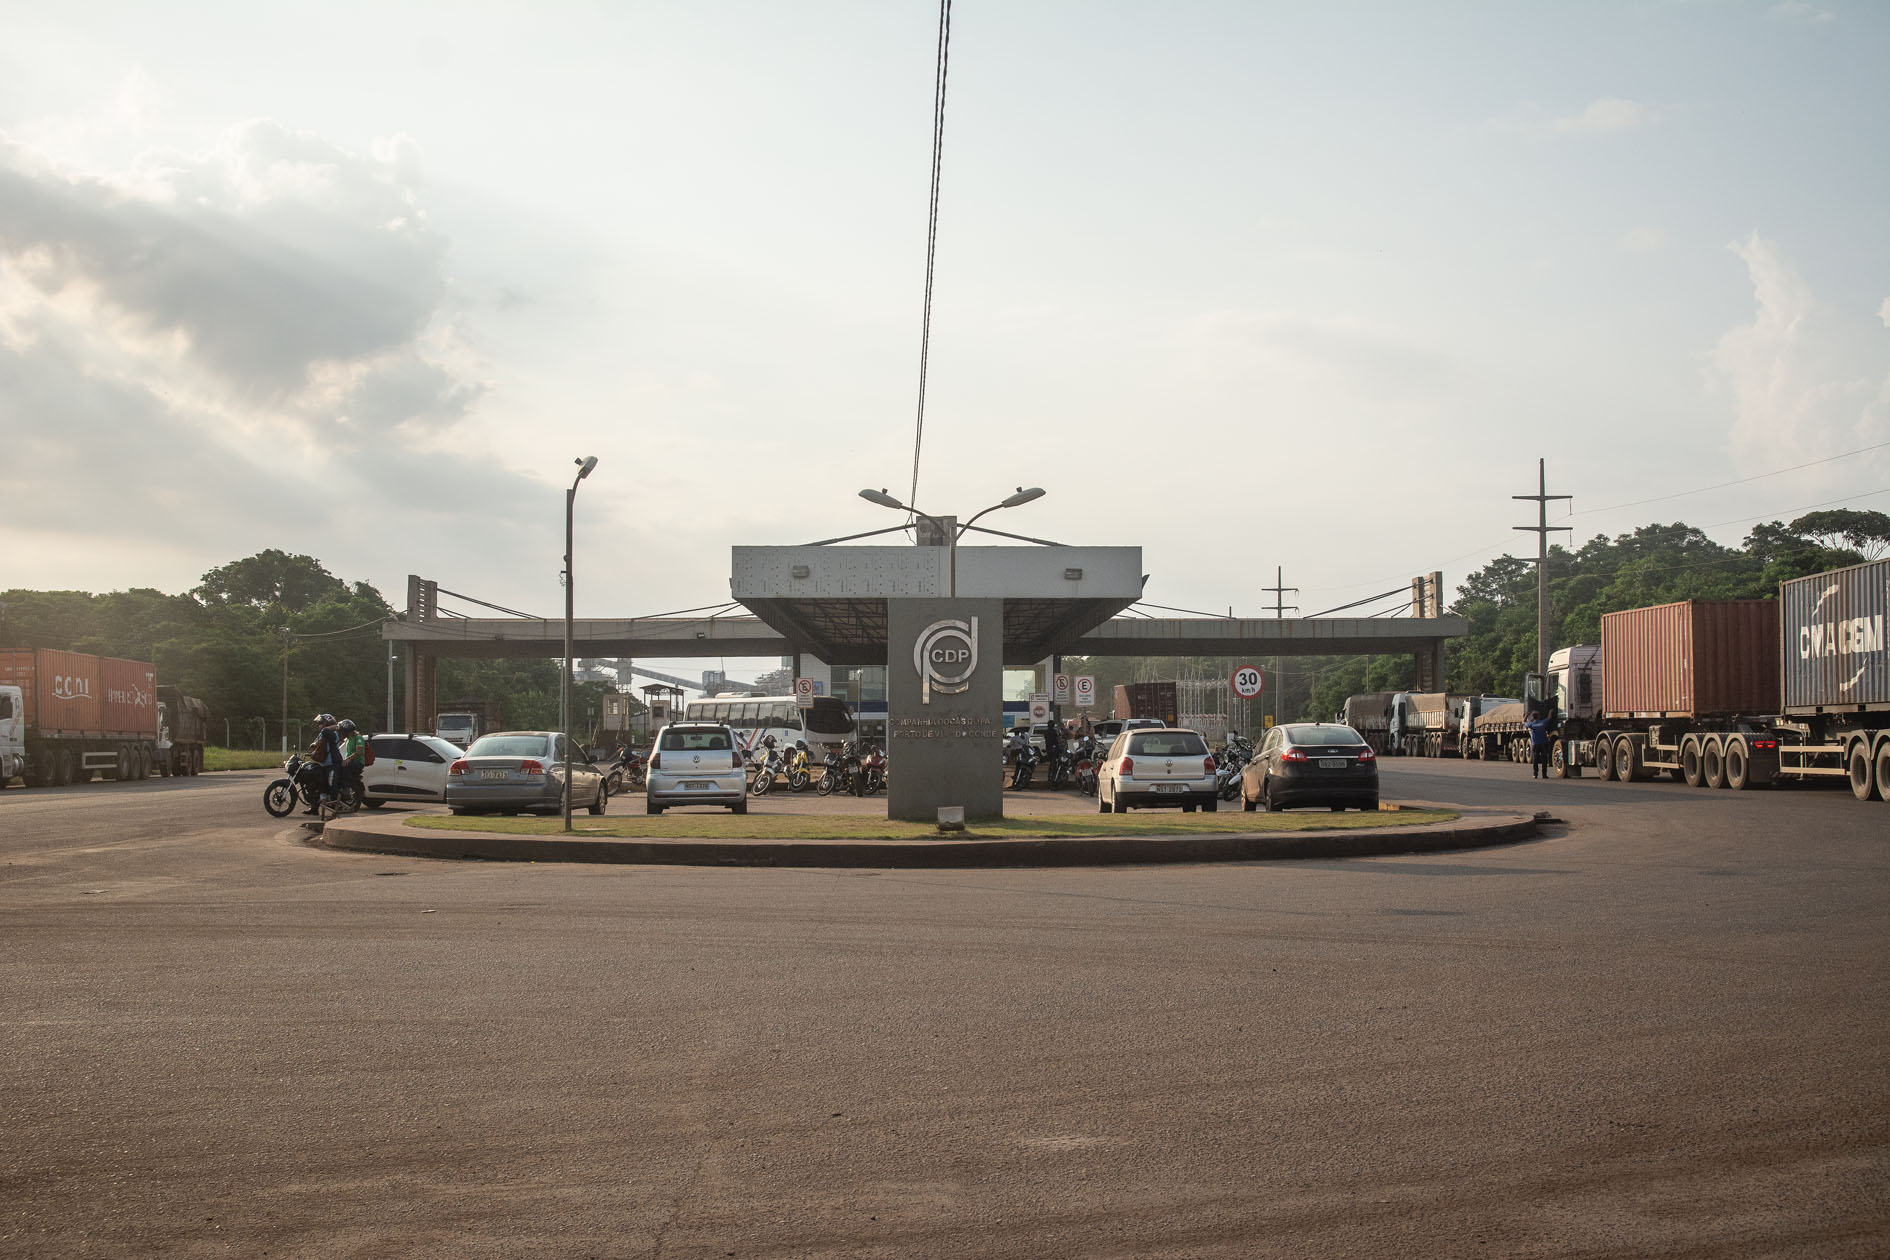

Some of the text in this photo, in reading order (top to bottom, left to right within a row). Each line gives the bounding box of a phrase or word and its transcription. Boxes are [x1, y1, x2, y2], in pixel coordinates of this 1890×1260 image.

[1801, 622, 1837, 659] CMA
[931, 649, 969, 663] CDP
[1239, 672, 1258, 686] 30
